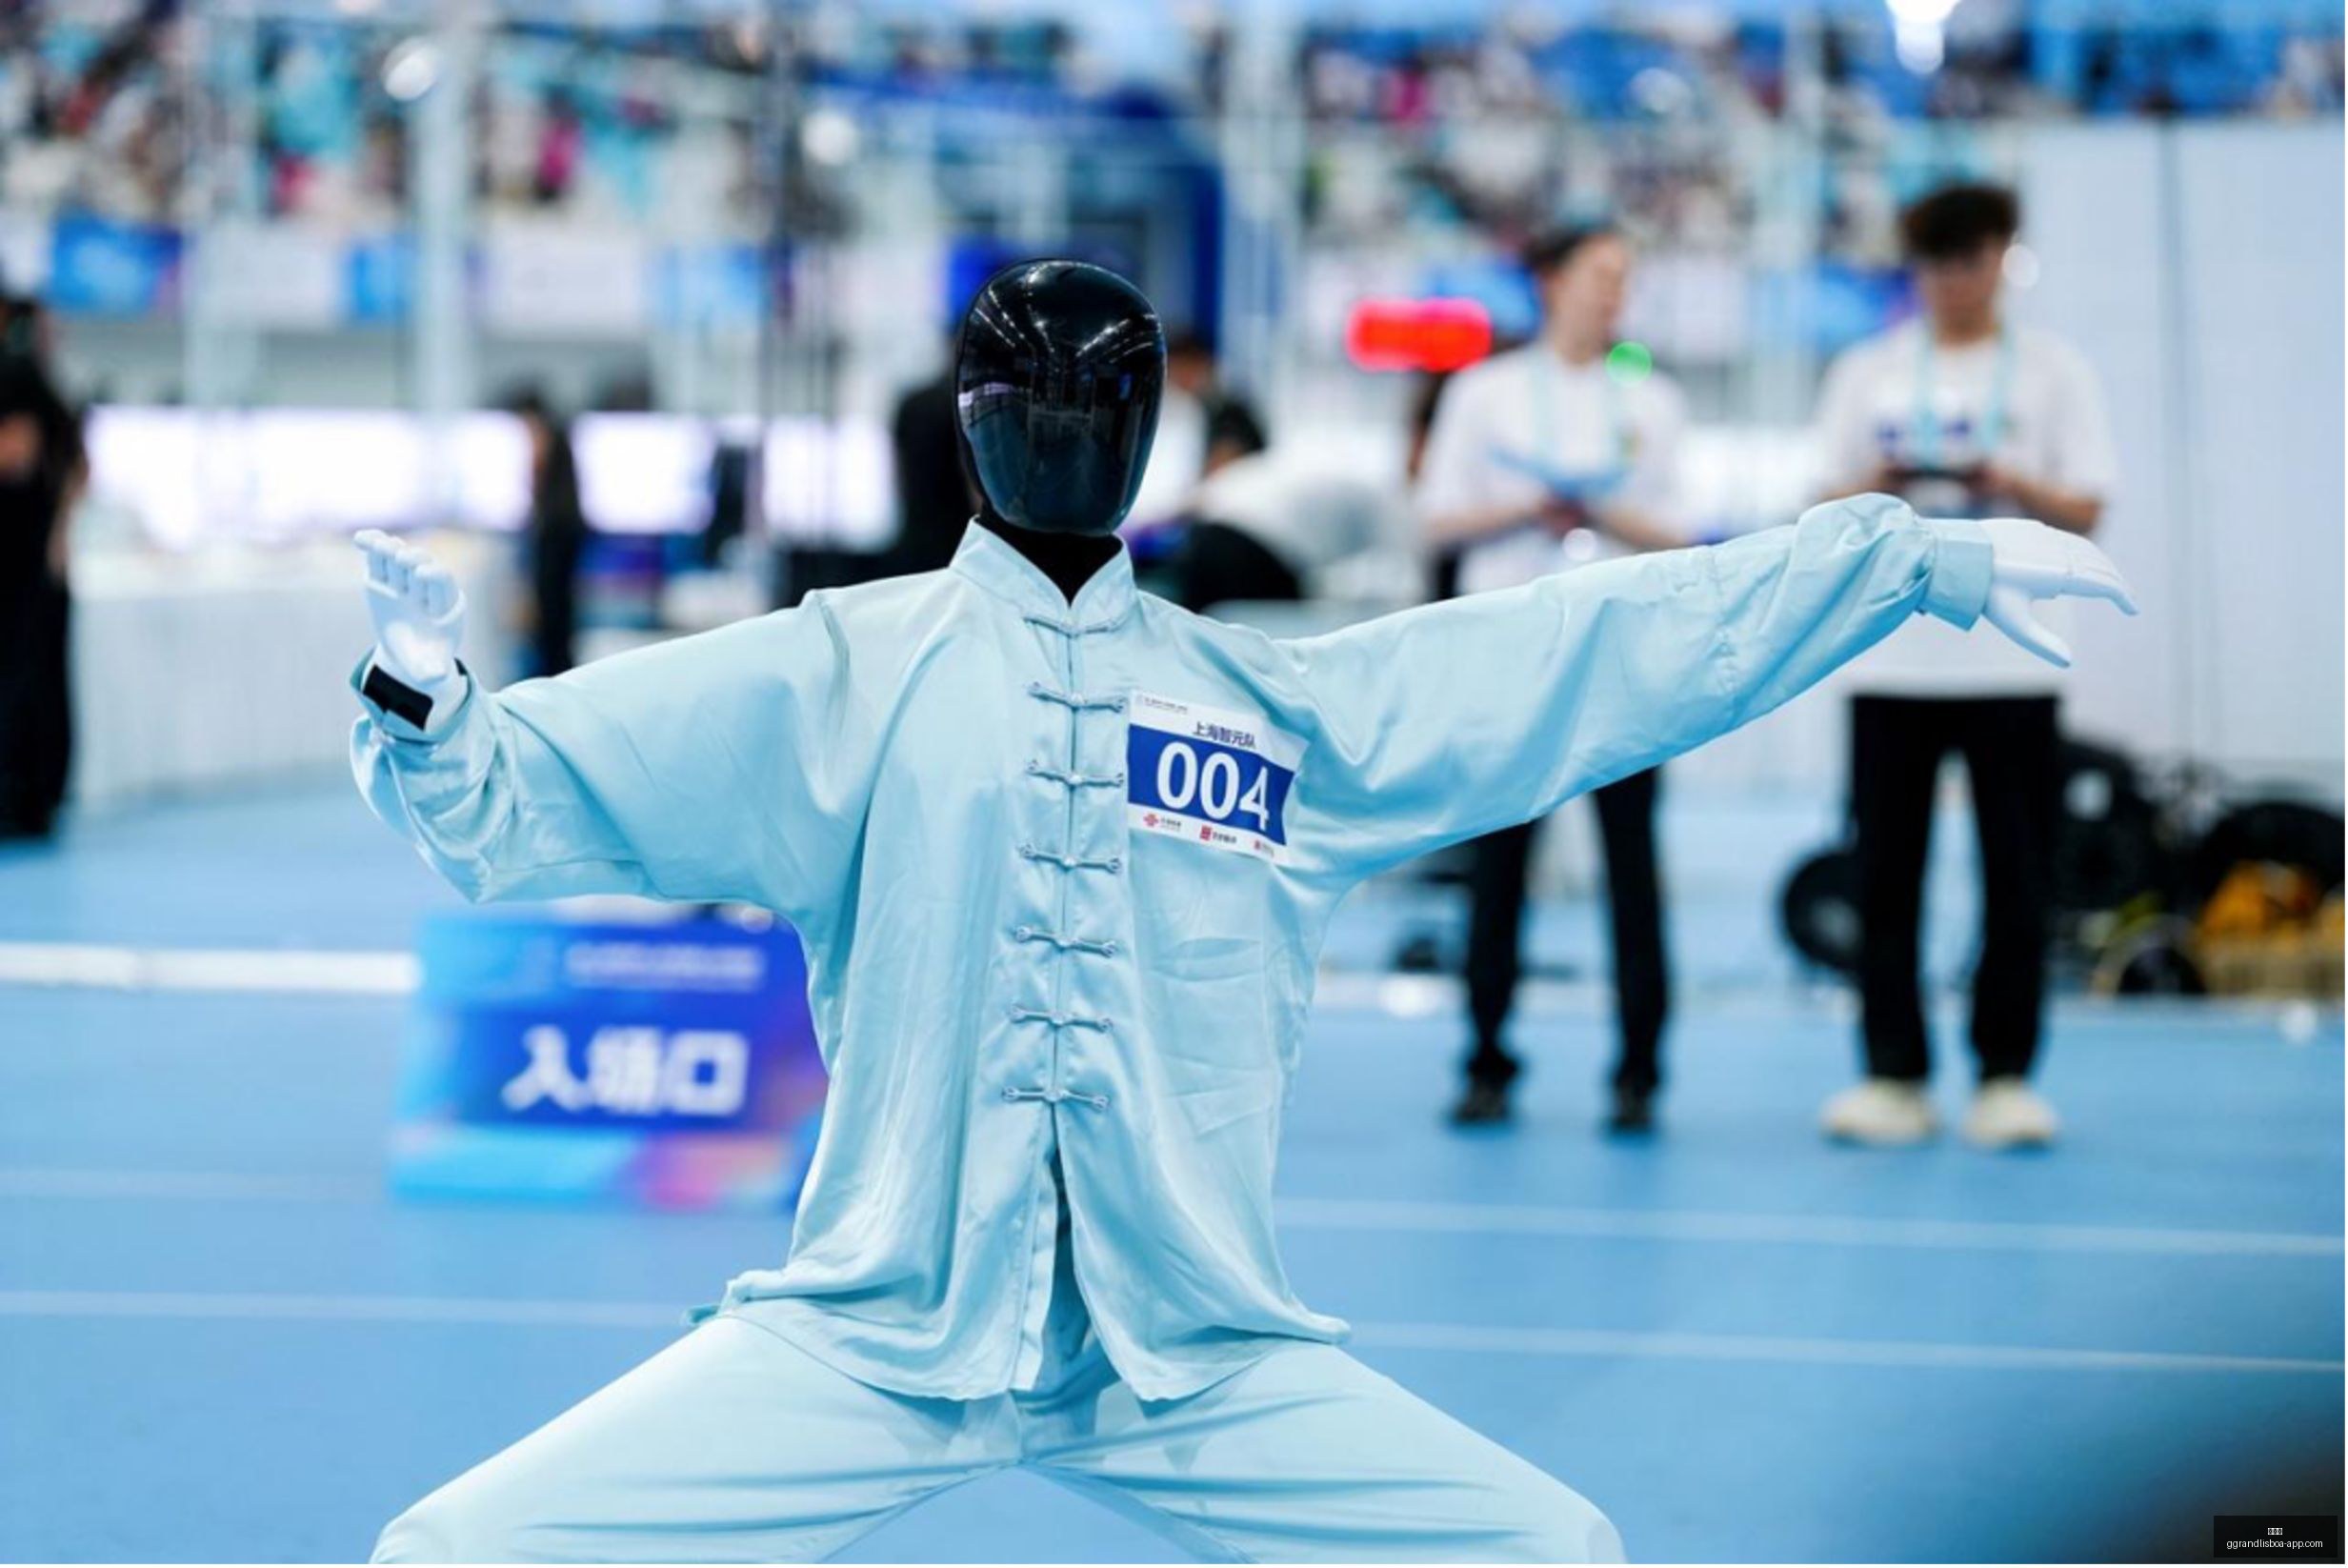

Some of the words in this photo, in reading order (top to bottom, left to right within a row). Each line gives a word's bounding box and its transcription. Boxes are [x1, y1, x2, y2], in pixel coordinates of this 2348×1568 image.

[1193, 720, 1256, 749] 上海智元队
[1157, 741, 1269, 832] 004
